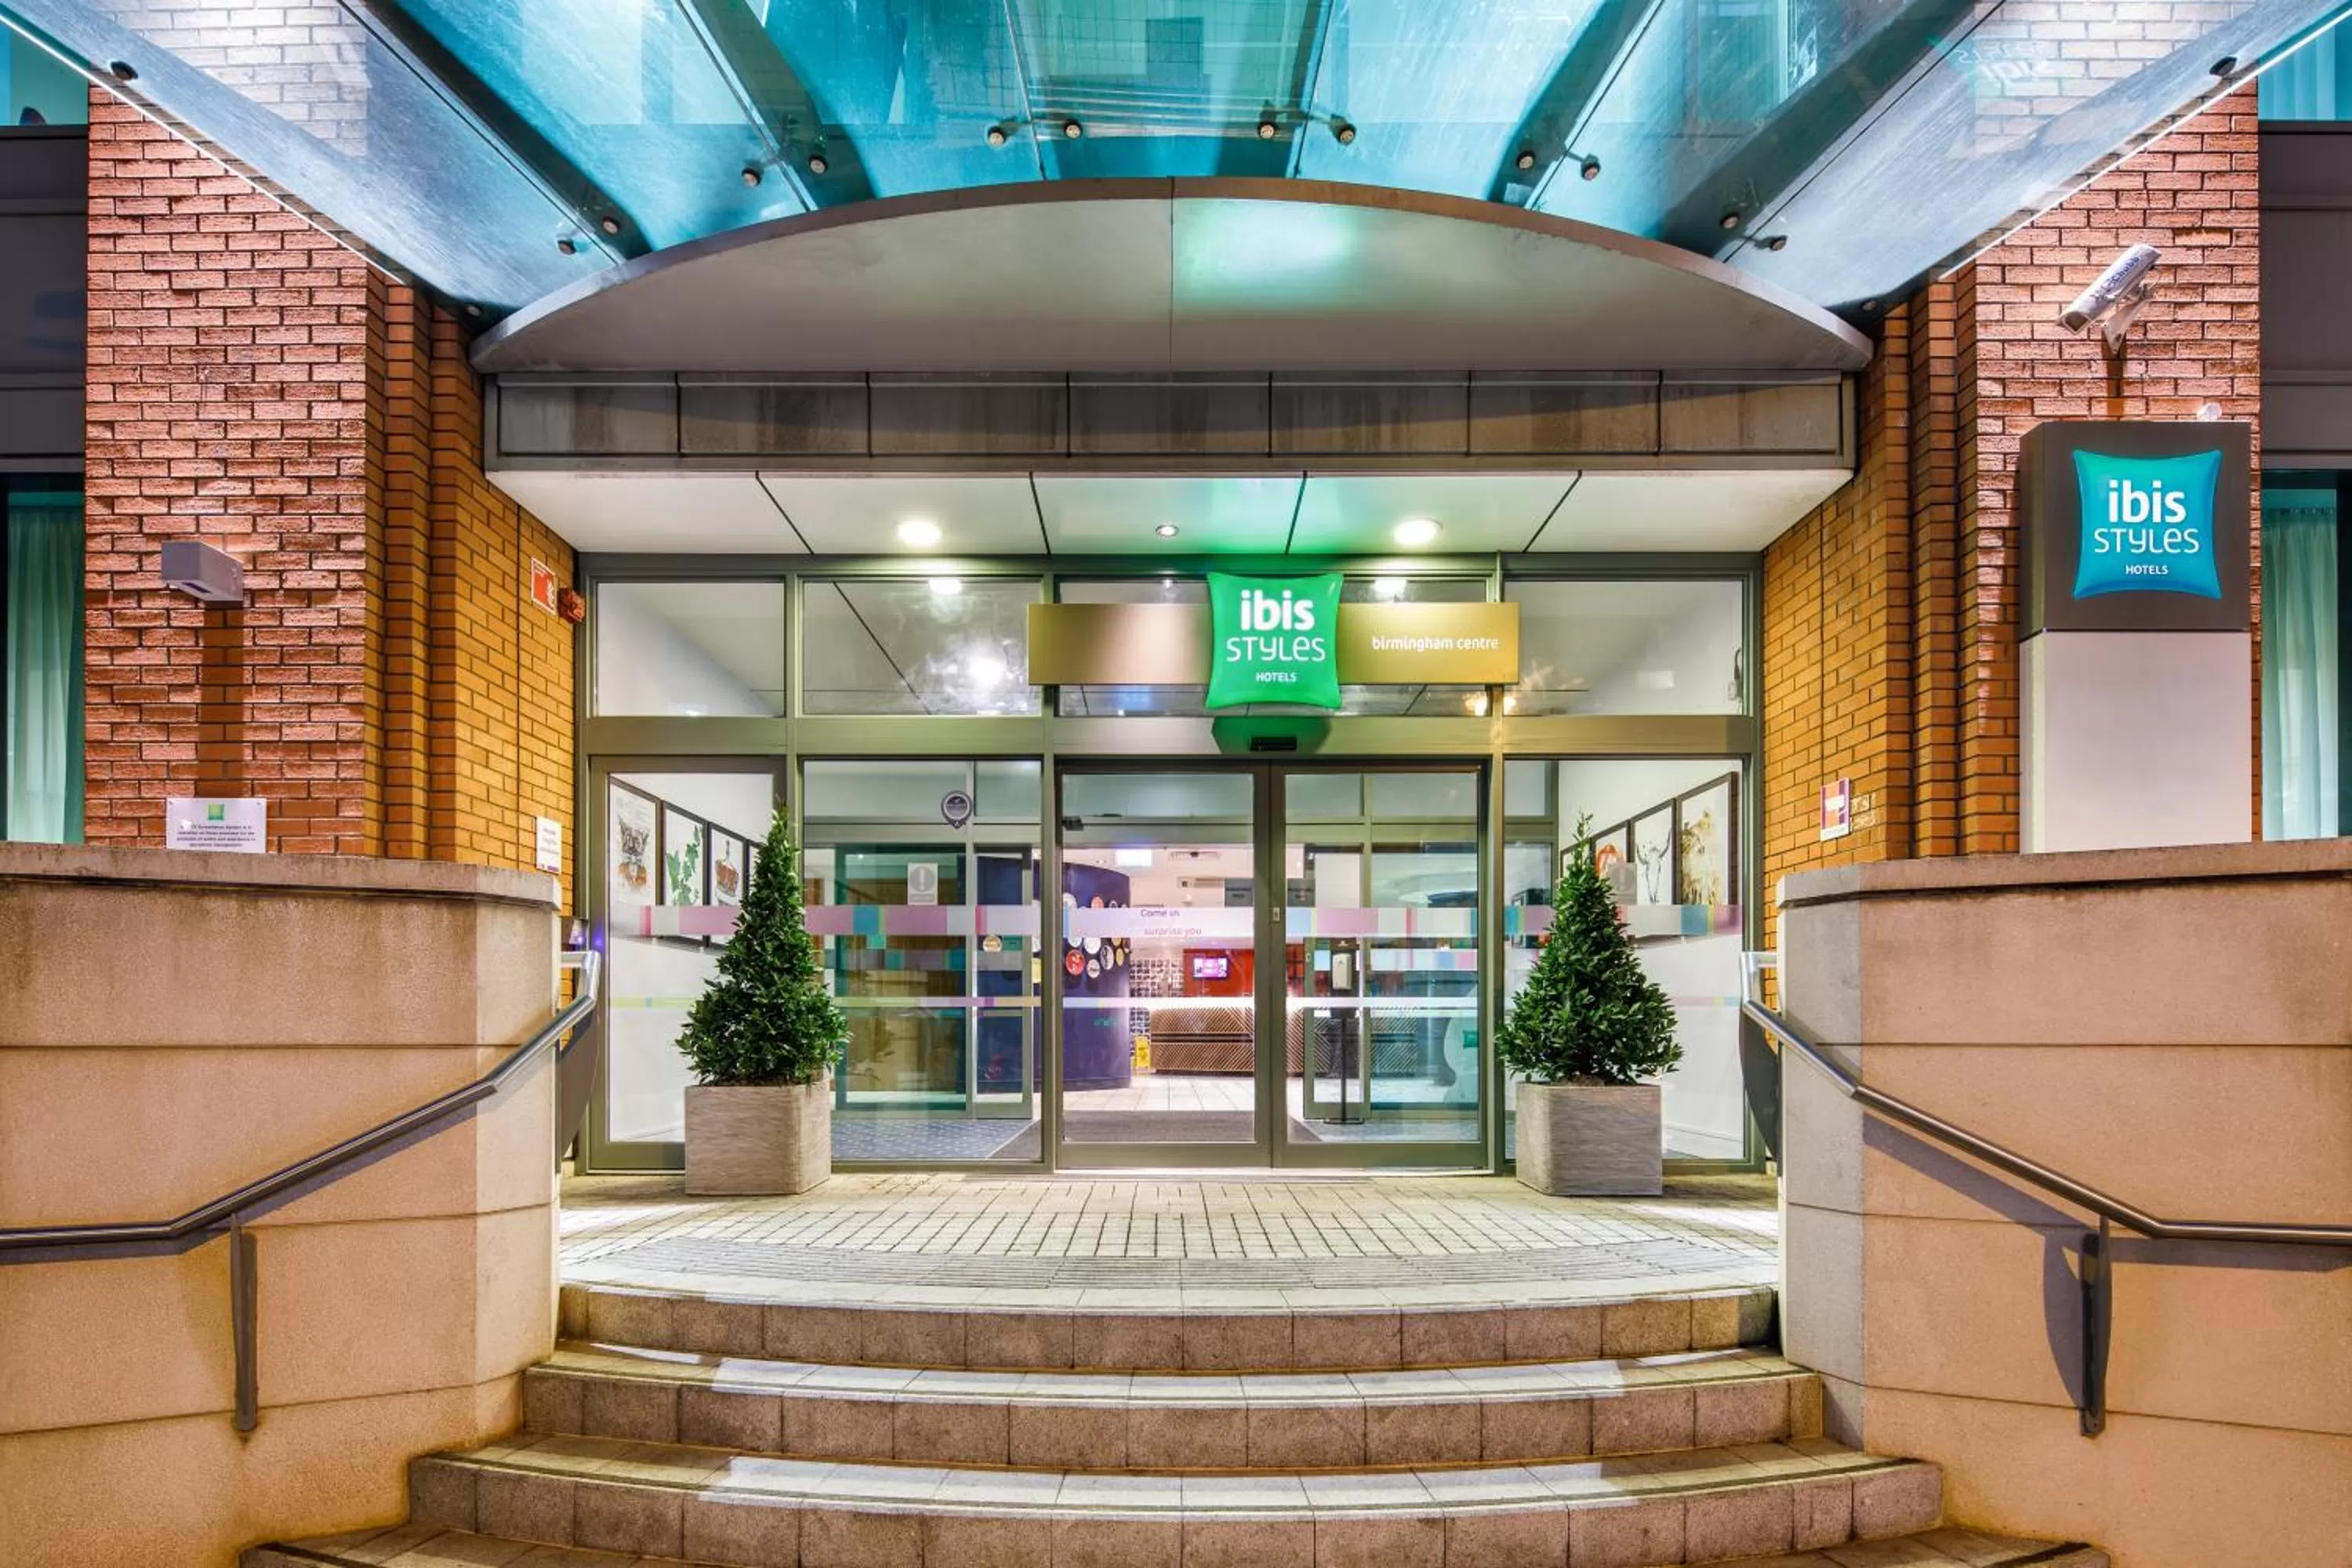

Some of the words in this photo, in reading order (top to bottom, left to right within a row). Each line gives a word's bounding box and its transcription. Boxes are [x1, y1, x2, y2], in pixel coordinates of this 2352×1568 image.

[2111, 257, 2140, 281] Chubb
[2109, 480, 2187, 523] ibis
[2125, 564, 2169, 575] HOTELS
[1241, 590, 1315, 630] ibis
[1372, 634, 1453, 652] birmingham
[1456, 636, 1499, 650] centre
[1256, 672, 1296, 682] HOTELS
